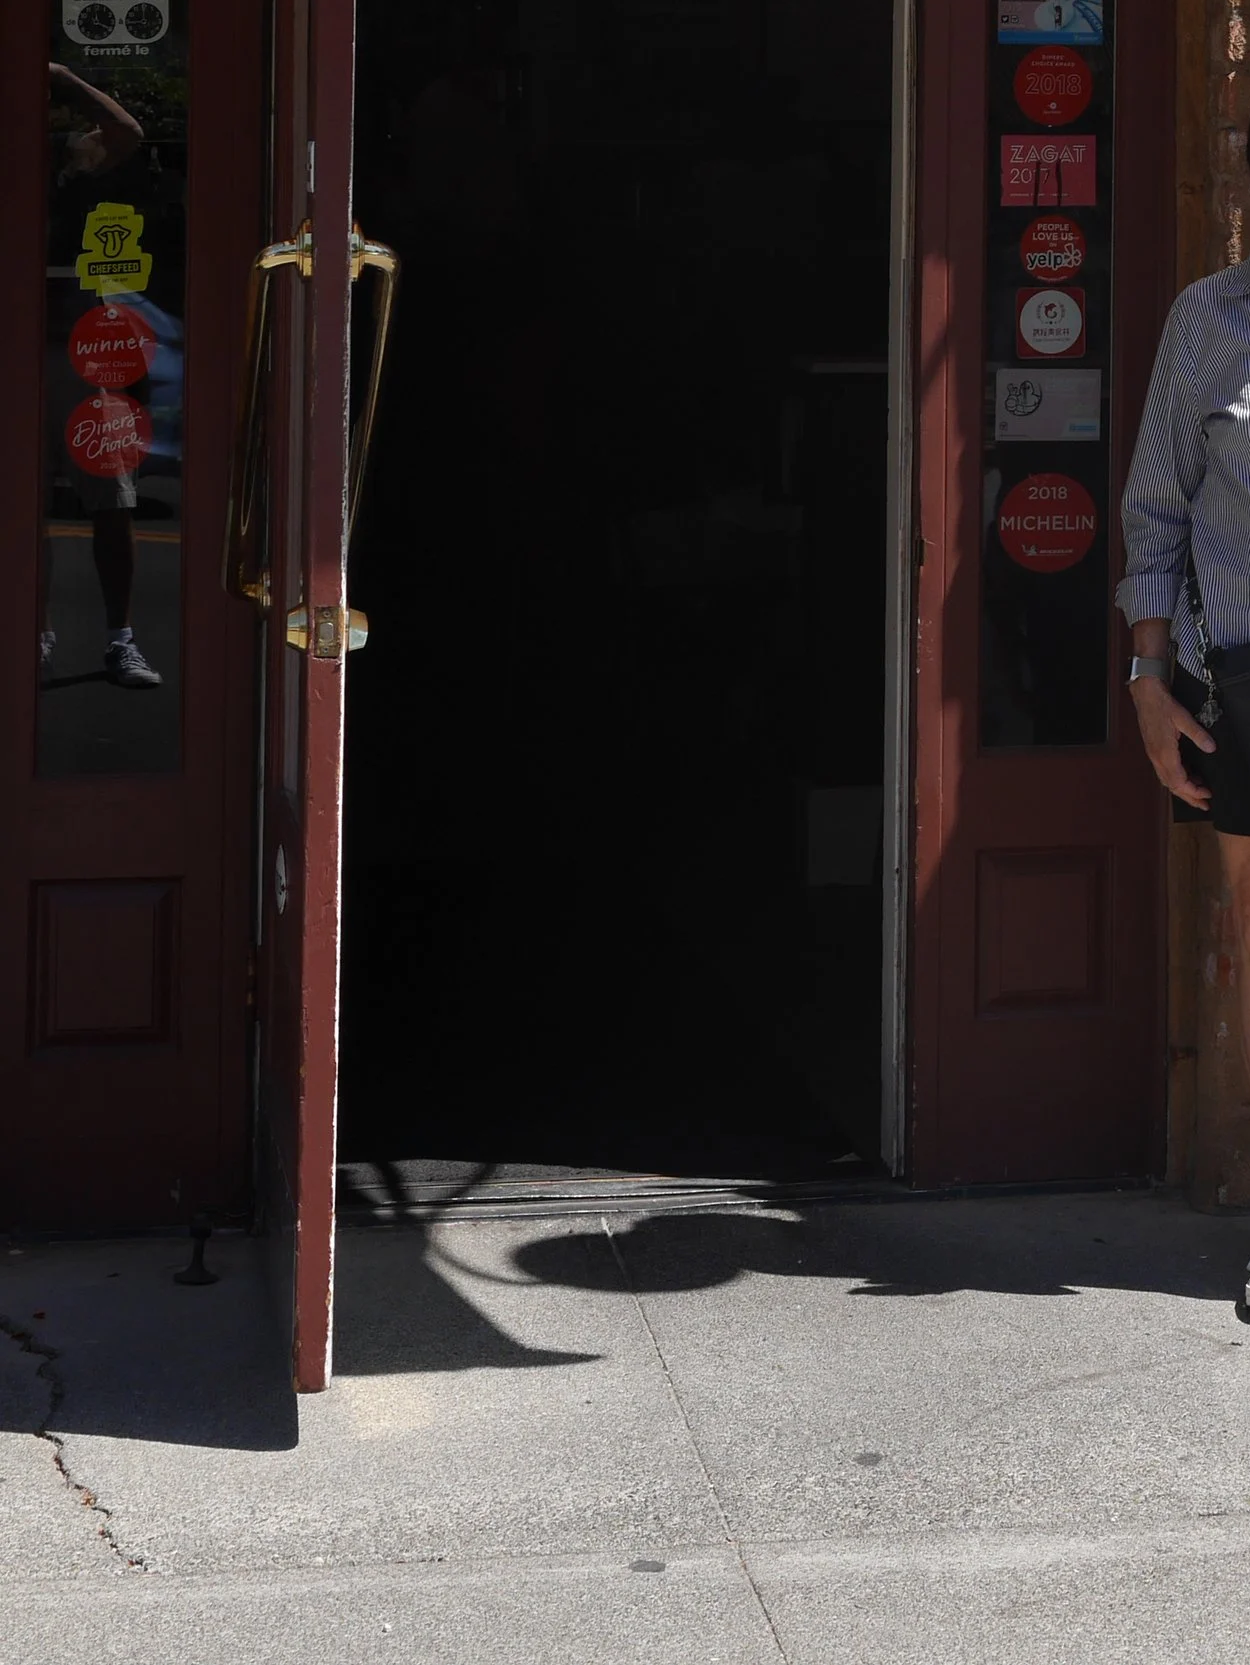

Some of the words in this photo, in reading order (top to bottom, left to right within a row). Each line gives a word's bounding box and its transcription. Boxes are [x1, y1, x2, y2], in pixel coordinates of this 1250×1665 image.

[83, 44, 132, 56] fermé
[135, 44, 150, 56] le
[1024, 72, 1083, 95] 2018
[1009, 144, 1087, 164] ZAGAT
[1009, 168, 1051, 185] 207
[1037, 223, 1070, 231] PEOPLE
[1032, 232, 1059, 241] LOVE
[1061, 232, 1074, 241] US
[89, 262, 140, 275] CHEFSFEED
[1026, 250, 1066, 271] yelp
[76, 336, 152, 356] winner
[96, 371, 126, 384] 2016
[72, 408, 142, 447] Diners'
[86, 432, 144, 460] Choice
[1028, 486, 1068, 500] 2018
[1000, 515, 1095, 531] MICHELIN
